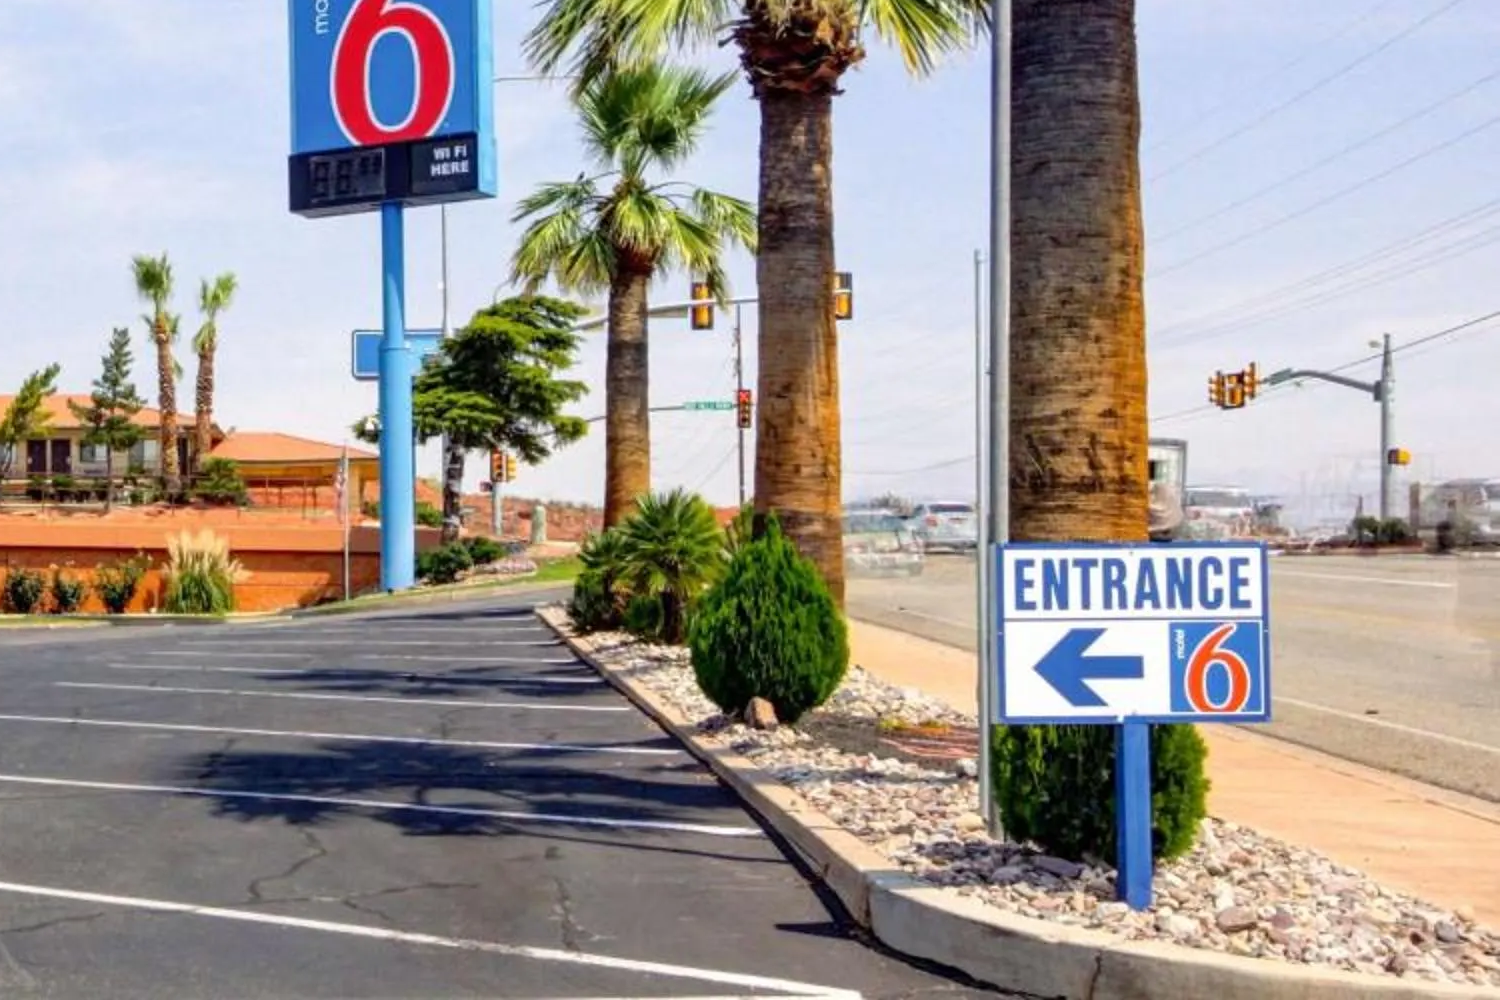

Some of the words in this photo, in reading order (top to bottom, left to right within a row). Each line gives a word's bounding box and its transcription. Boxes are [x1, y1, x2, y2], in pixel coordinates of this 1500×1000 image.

[431, 160, 469, 176] HERE
[1014, 556, 1252, 611] ENTRANCE
[1184, 622, 1251, 713] 6
